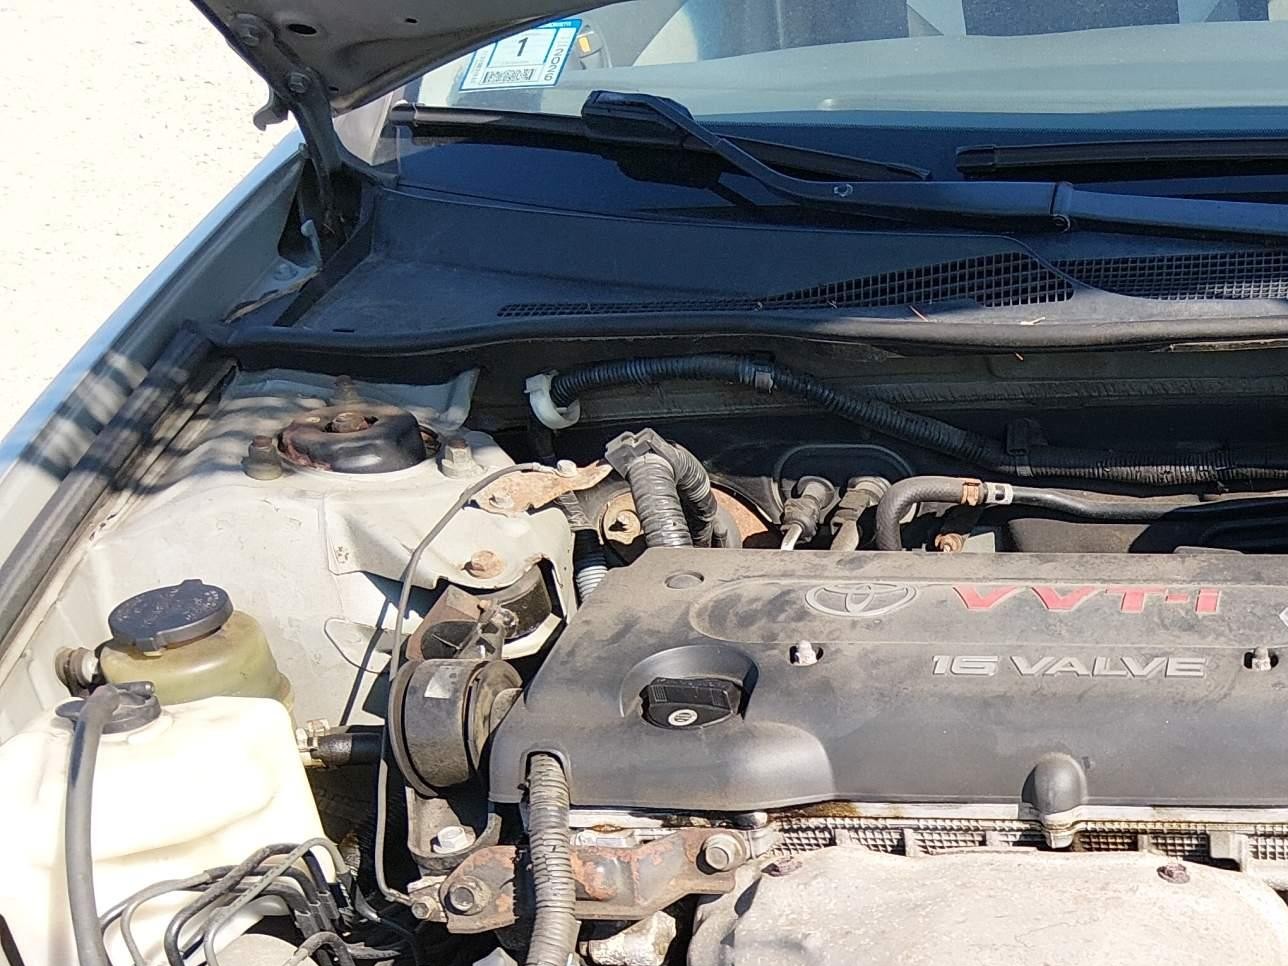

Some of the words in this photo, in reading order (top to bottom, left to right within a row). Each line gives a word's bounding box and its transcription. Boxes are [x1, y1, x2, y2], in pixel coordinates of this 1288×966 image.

[516, 36, 529, 57] 1
[543, 48, 564, 81] 2026
[932, 655, 998, 677] 16
[1010, 655, 1206, 679] VALVE
